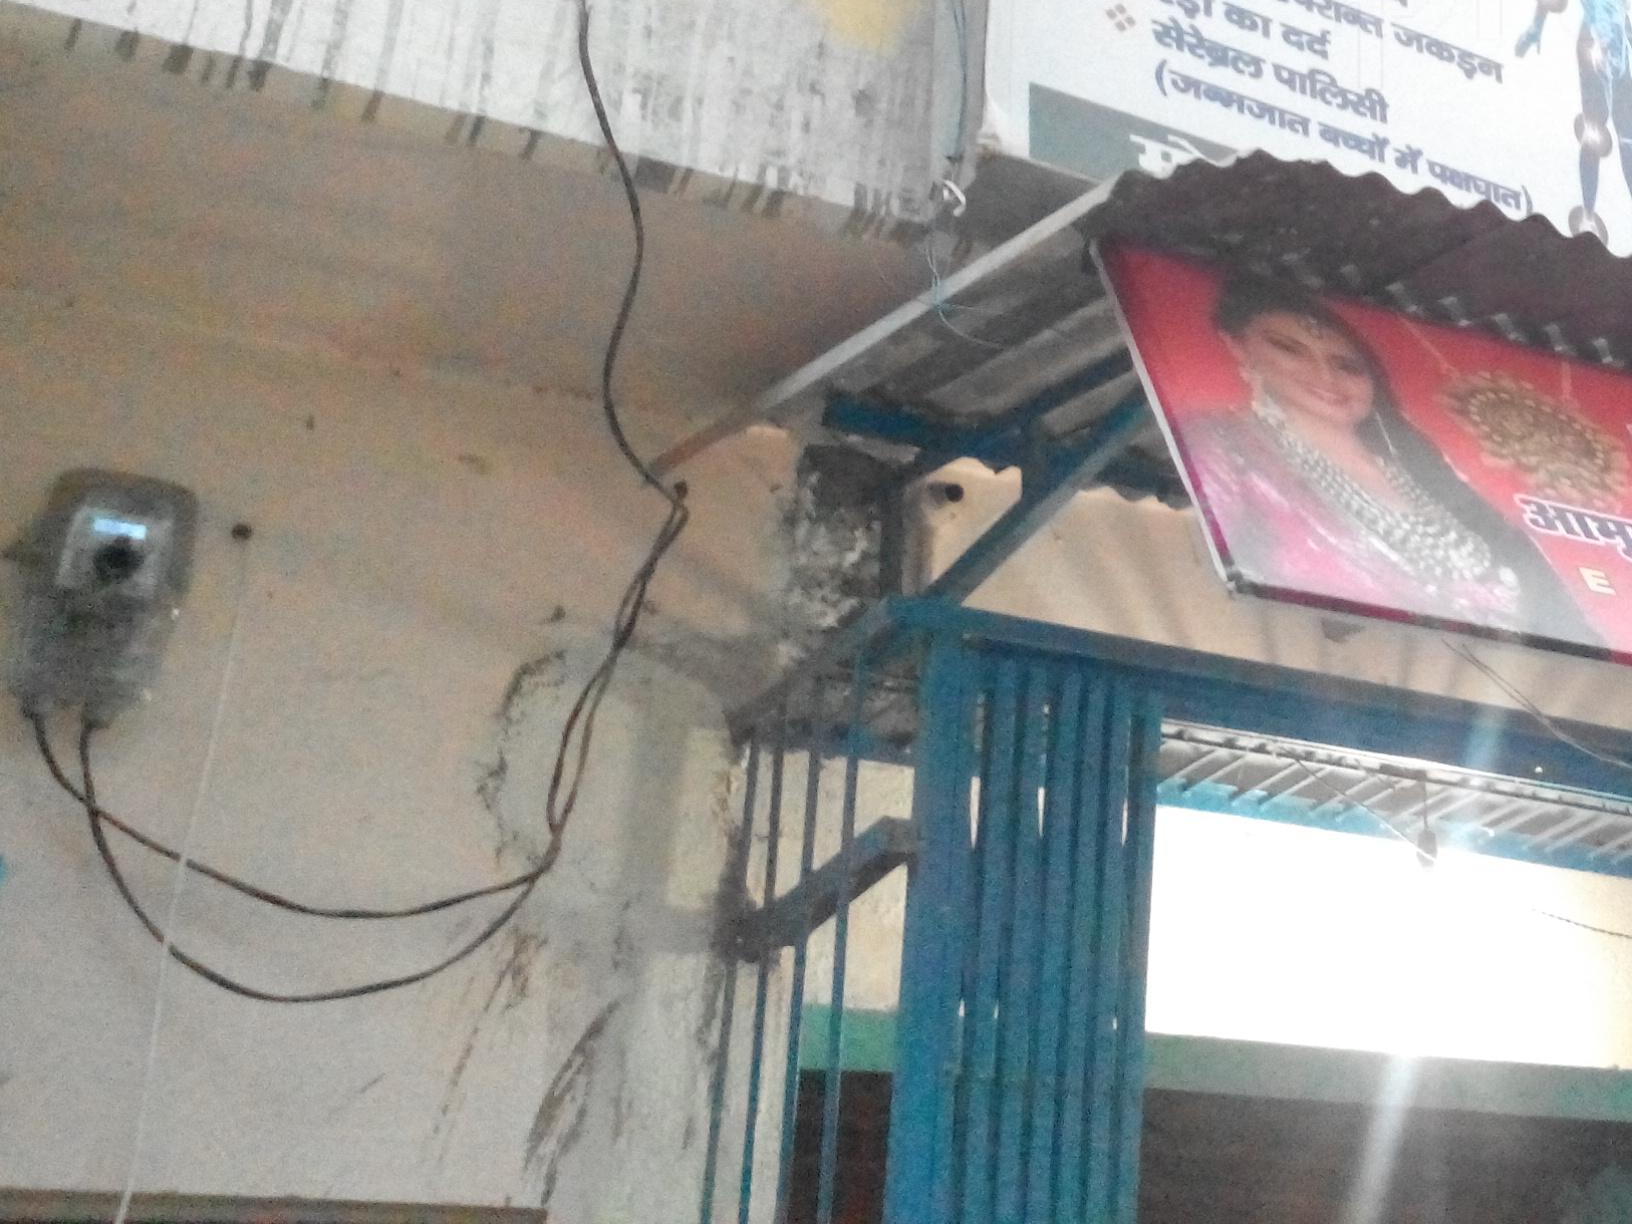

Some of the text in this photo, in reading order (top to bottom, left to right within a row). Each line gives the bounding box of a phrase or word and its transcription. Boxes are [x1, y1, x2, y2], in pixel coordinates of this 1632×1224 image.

[1223, 1, 1272, 38] का
[1280, 23, 1331, 60] दर्द
[1272, 63, 1389, 124] पालिसी
[1394, 144, 1424, 175] में
[1579, 567, 1615, 595] E
